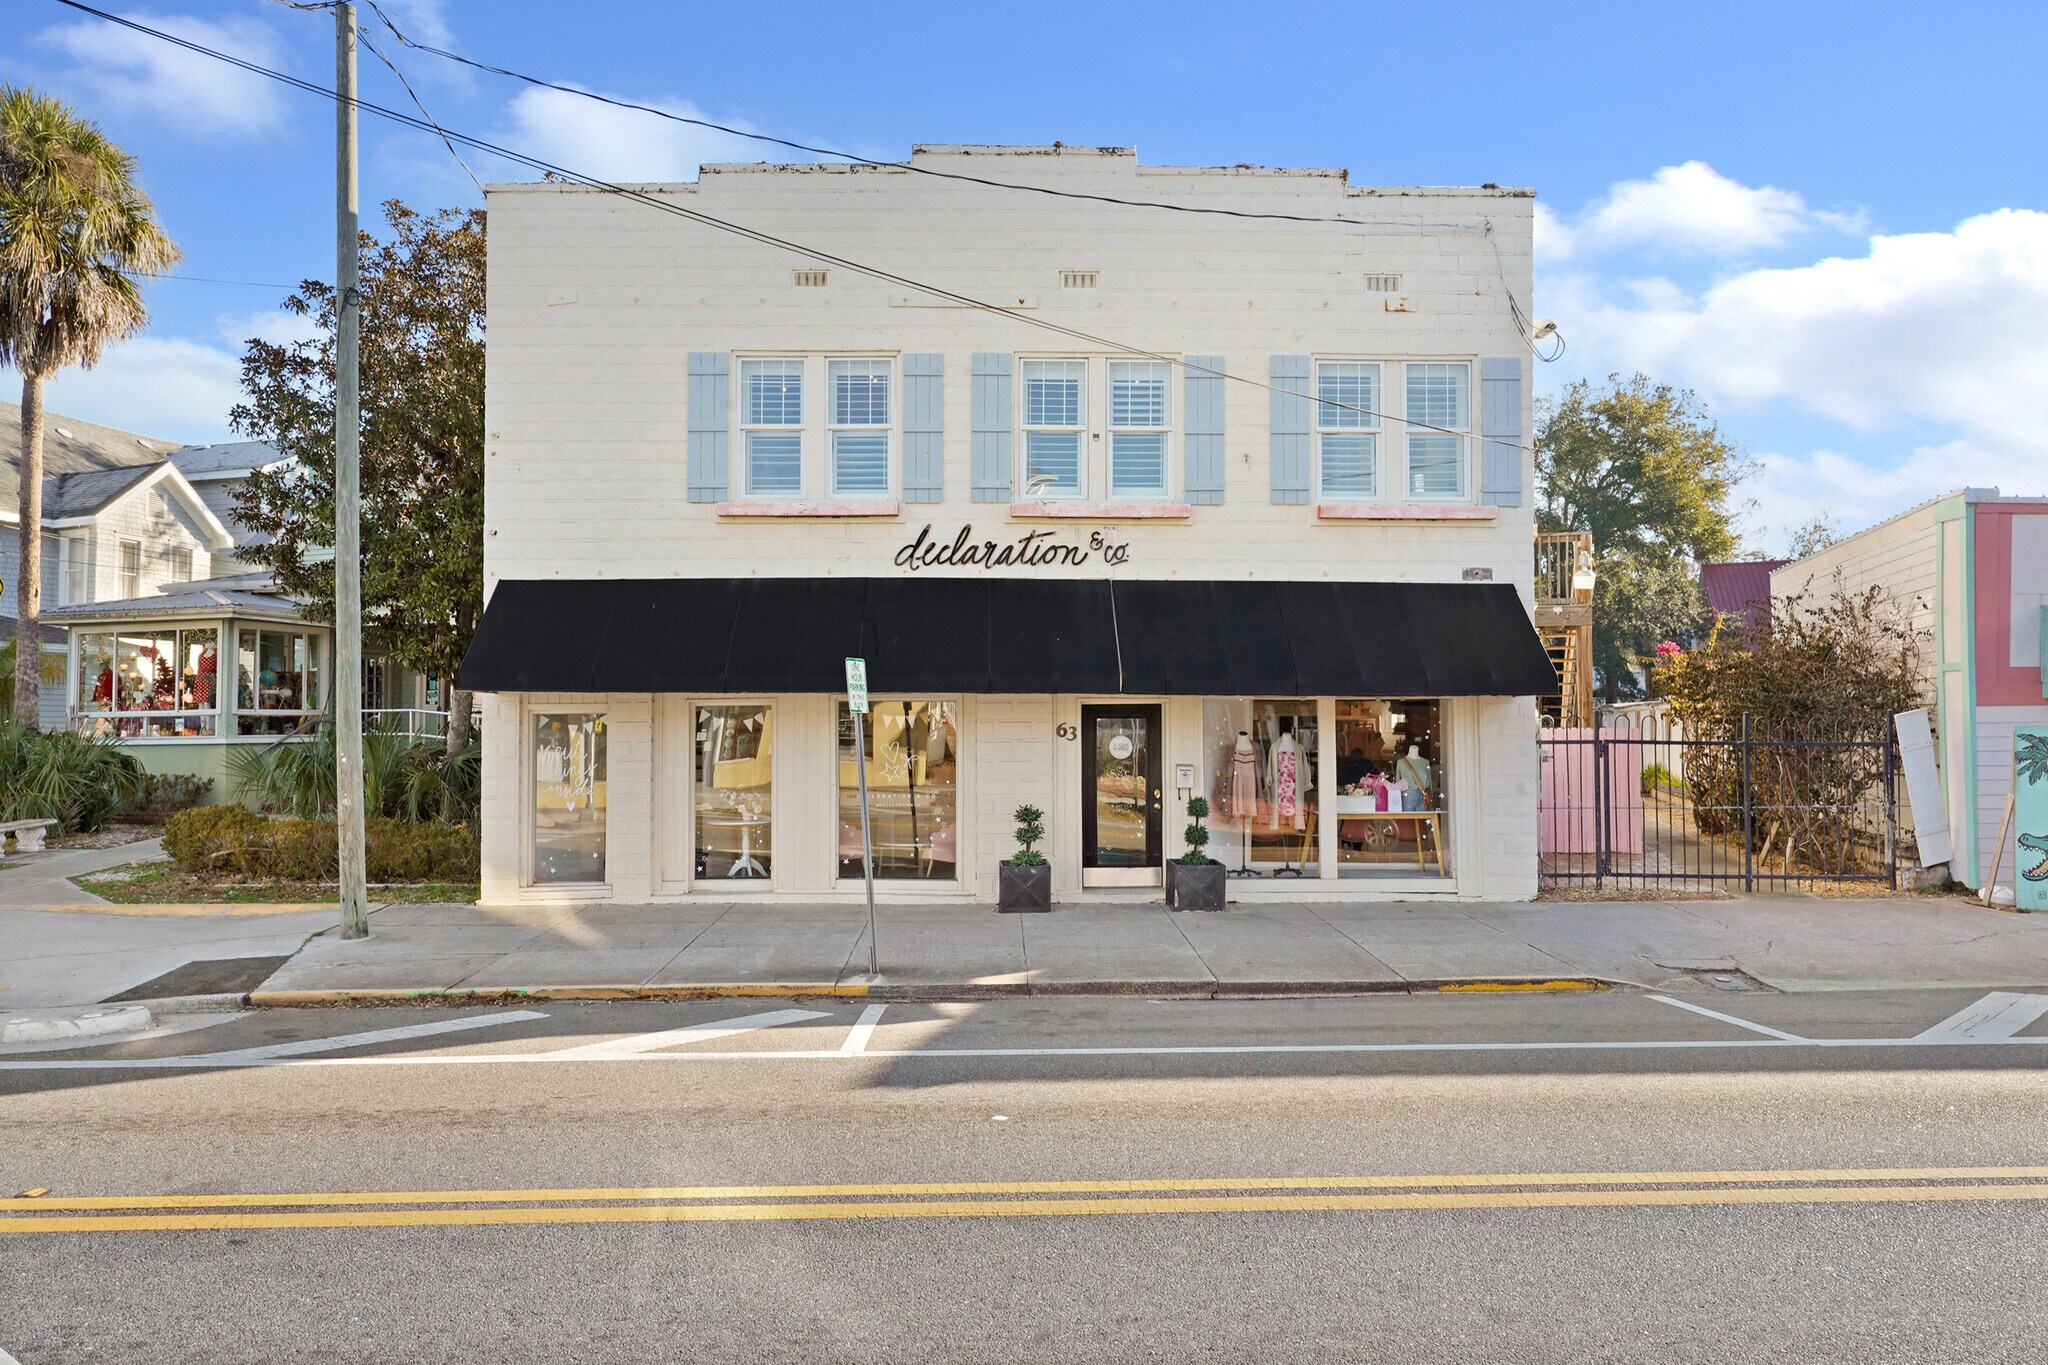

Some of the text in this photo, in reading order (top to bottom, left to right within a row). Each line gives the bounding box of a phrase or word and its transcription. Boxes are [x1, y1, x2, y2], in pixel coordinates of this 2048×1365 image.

[894, 523, 1088, 571] declaration
[1089, 531, 1104, 550] &
[850, 673, 863, 682] HOUR
[849, 682, 866, 692] PARKING
[1056, 722, 1077, 741] 63
[1112, 743, 1129, 751] CLOSED
[544, 777, 595, 799] inside
